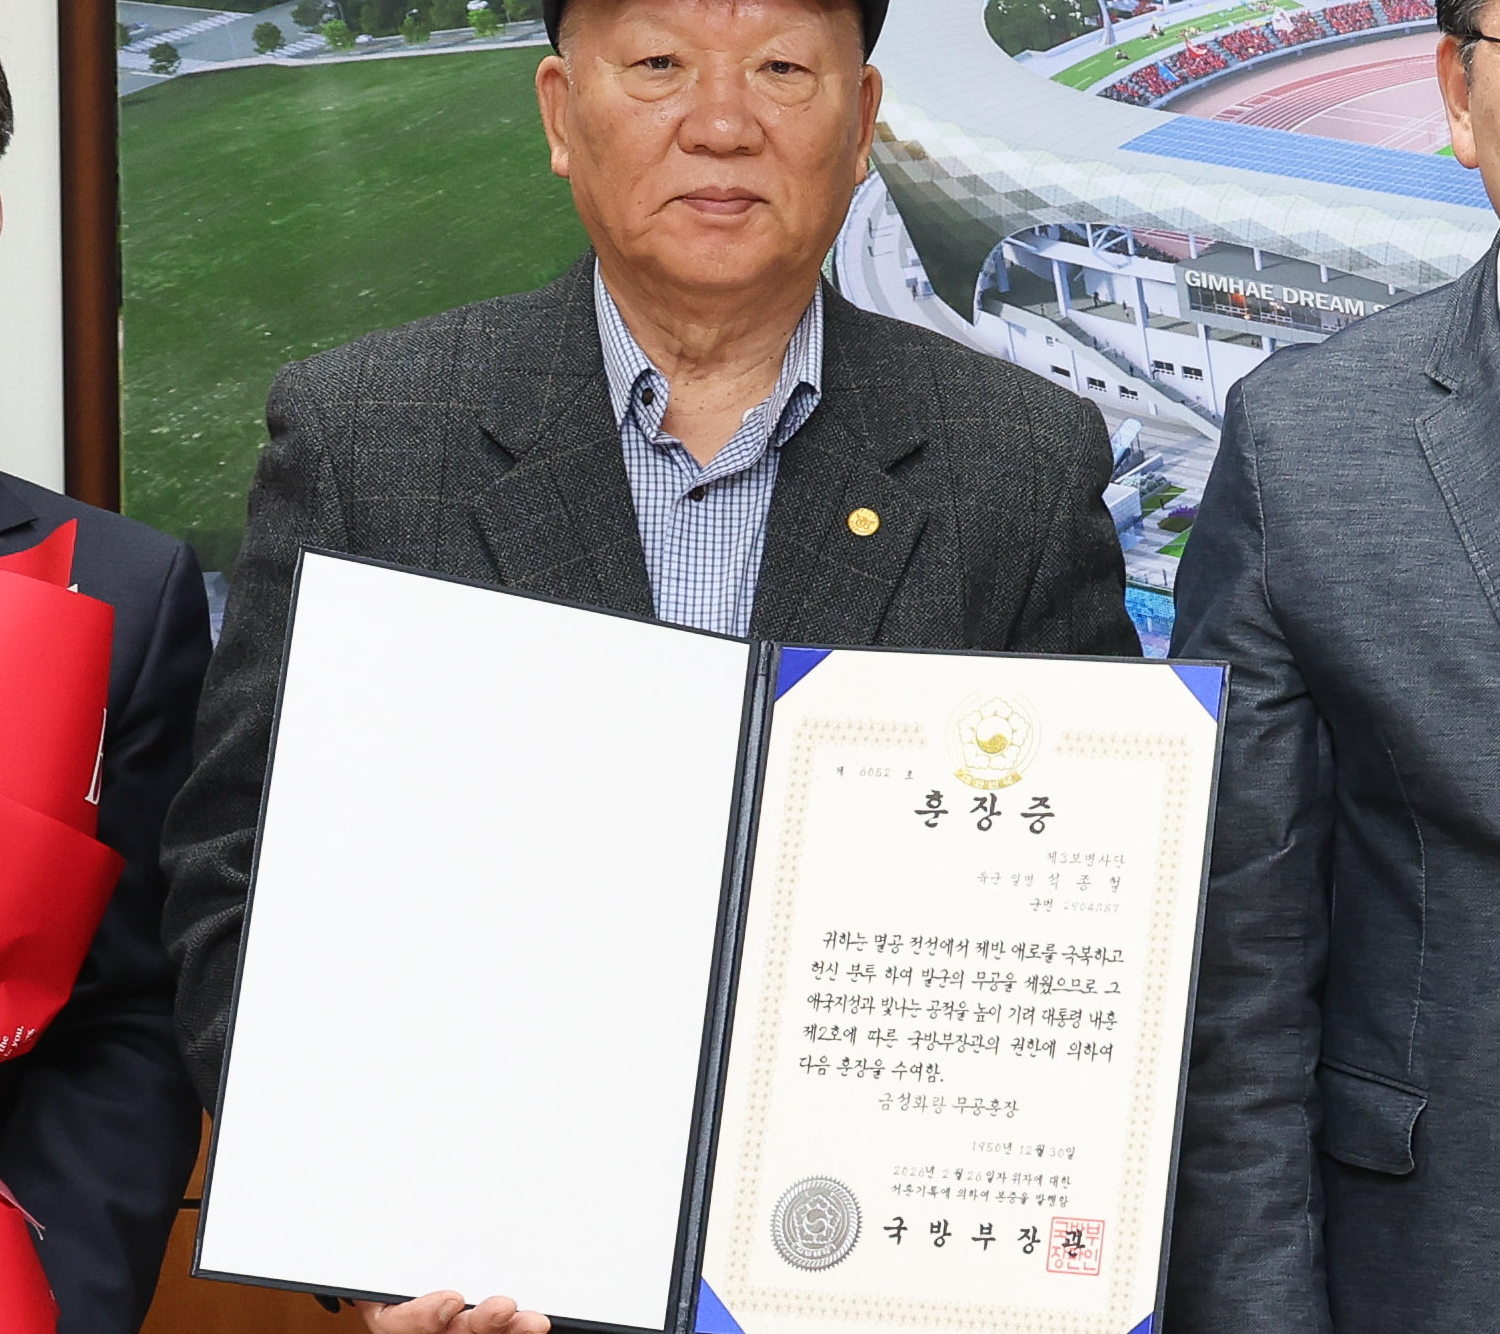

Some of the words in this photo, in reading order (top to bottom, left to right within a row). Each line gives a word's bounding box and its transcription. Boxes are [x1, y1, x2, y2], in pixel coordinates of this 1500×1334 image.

[1184, 269, 1275, 301] GIMHAE
[1282, 287, 1366, 317] DREAM
[822, 930, 869, 952] 귀하는
[874, 933, 904, 955] 멸공
[909, 935, 970, 959] 전선에서
[975, 939, 1006, 961] 제반
[1010, 941, 1058, 964] 애로를
[1061, 944, 1125, 967] 극복하고
[811, 960, 839, 982] 헌신
[845, 962, 877, 984] 분투
[884, 965, 913, 987] 하여
[921, 967, 965, 990] 발군의
[971, 971, 1018, 993] 무공을
[1024, 973, 1098, 996] 세웠으므로
[1103, 981, 1121, 994] 그
[806, 991, 876, 1015] 애국지성과
[881, 996, 923, 1019] 빛나는
[925, 999, 970, 1022] 공적을
[973, 1002, 1002, 1024] 높이
[1008, 1004, 1036, 1026] 기려
[1041, 1006, 1083, 1029] 대통령
[1089, 1009, 1118, 1031] 내훈
[803, 1023, 858, 1046] 제2호에
[867, 1027, 899, 1049] 따른
[907, 1030, 1000, 1056] 국방부장관의
[1010, 1036, 1057, 1060] 권한에
[1066, 1040, 1114, 1063] 의하여
[799, 1054, 831, 1076] 다음
[836, 1056, 886, 1080] 훈장을
[891, 1060, 944, 1083] 수여함.
[878, 1092, 947, 1115] 금성화랑
[953, 1096, 1019, 1119] 무공훈장
